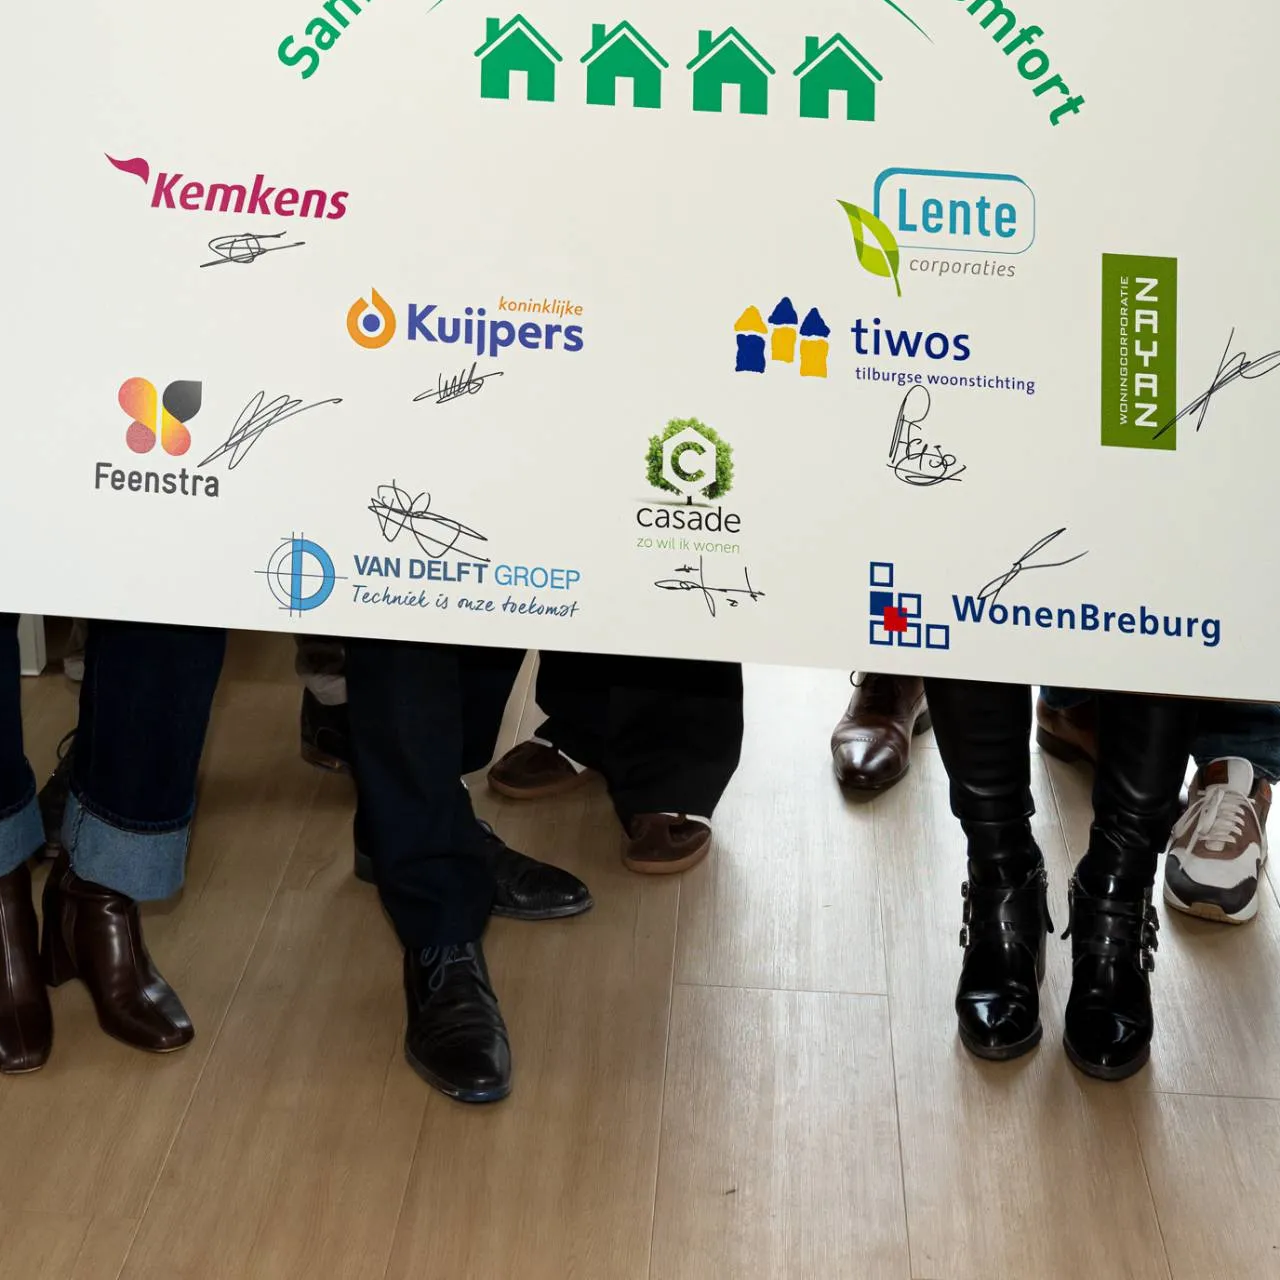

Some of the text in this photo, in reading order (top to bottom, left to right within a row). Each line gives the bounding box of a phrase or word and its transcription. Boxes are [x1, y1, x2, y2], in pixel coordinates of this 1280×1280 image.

[150, 171, 350, 221] Kemkens
[898, 187, 1018, 238] Lente
[909, 257, 1016, 278] corporaties
[498, 295, 584, 318] koninklijke
[407, 301, 585, 358] Kuijpers
[850, 317, 971, 362] tiwos
[1119, 275, 1129, 425] WONINGCORPORATIE
[1134, 276, 1159, 428] ZAYAZ
[854, 366, 1036, 396] tilburgse woonstichting
[94, 461, 220, 498] Feenstra
[636, 506, 741, 533] casade
[636, 536, 741, 555] zo wil ik wonen
[353, 554, 581, 590] VAN DELFT GROEP
[352, 584, 580, 618] Techniek is onze toekomst
[951, 593, 1222, 648] WonenBreburg
